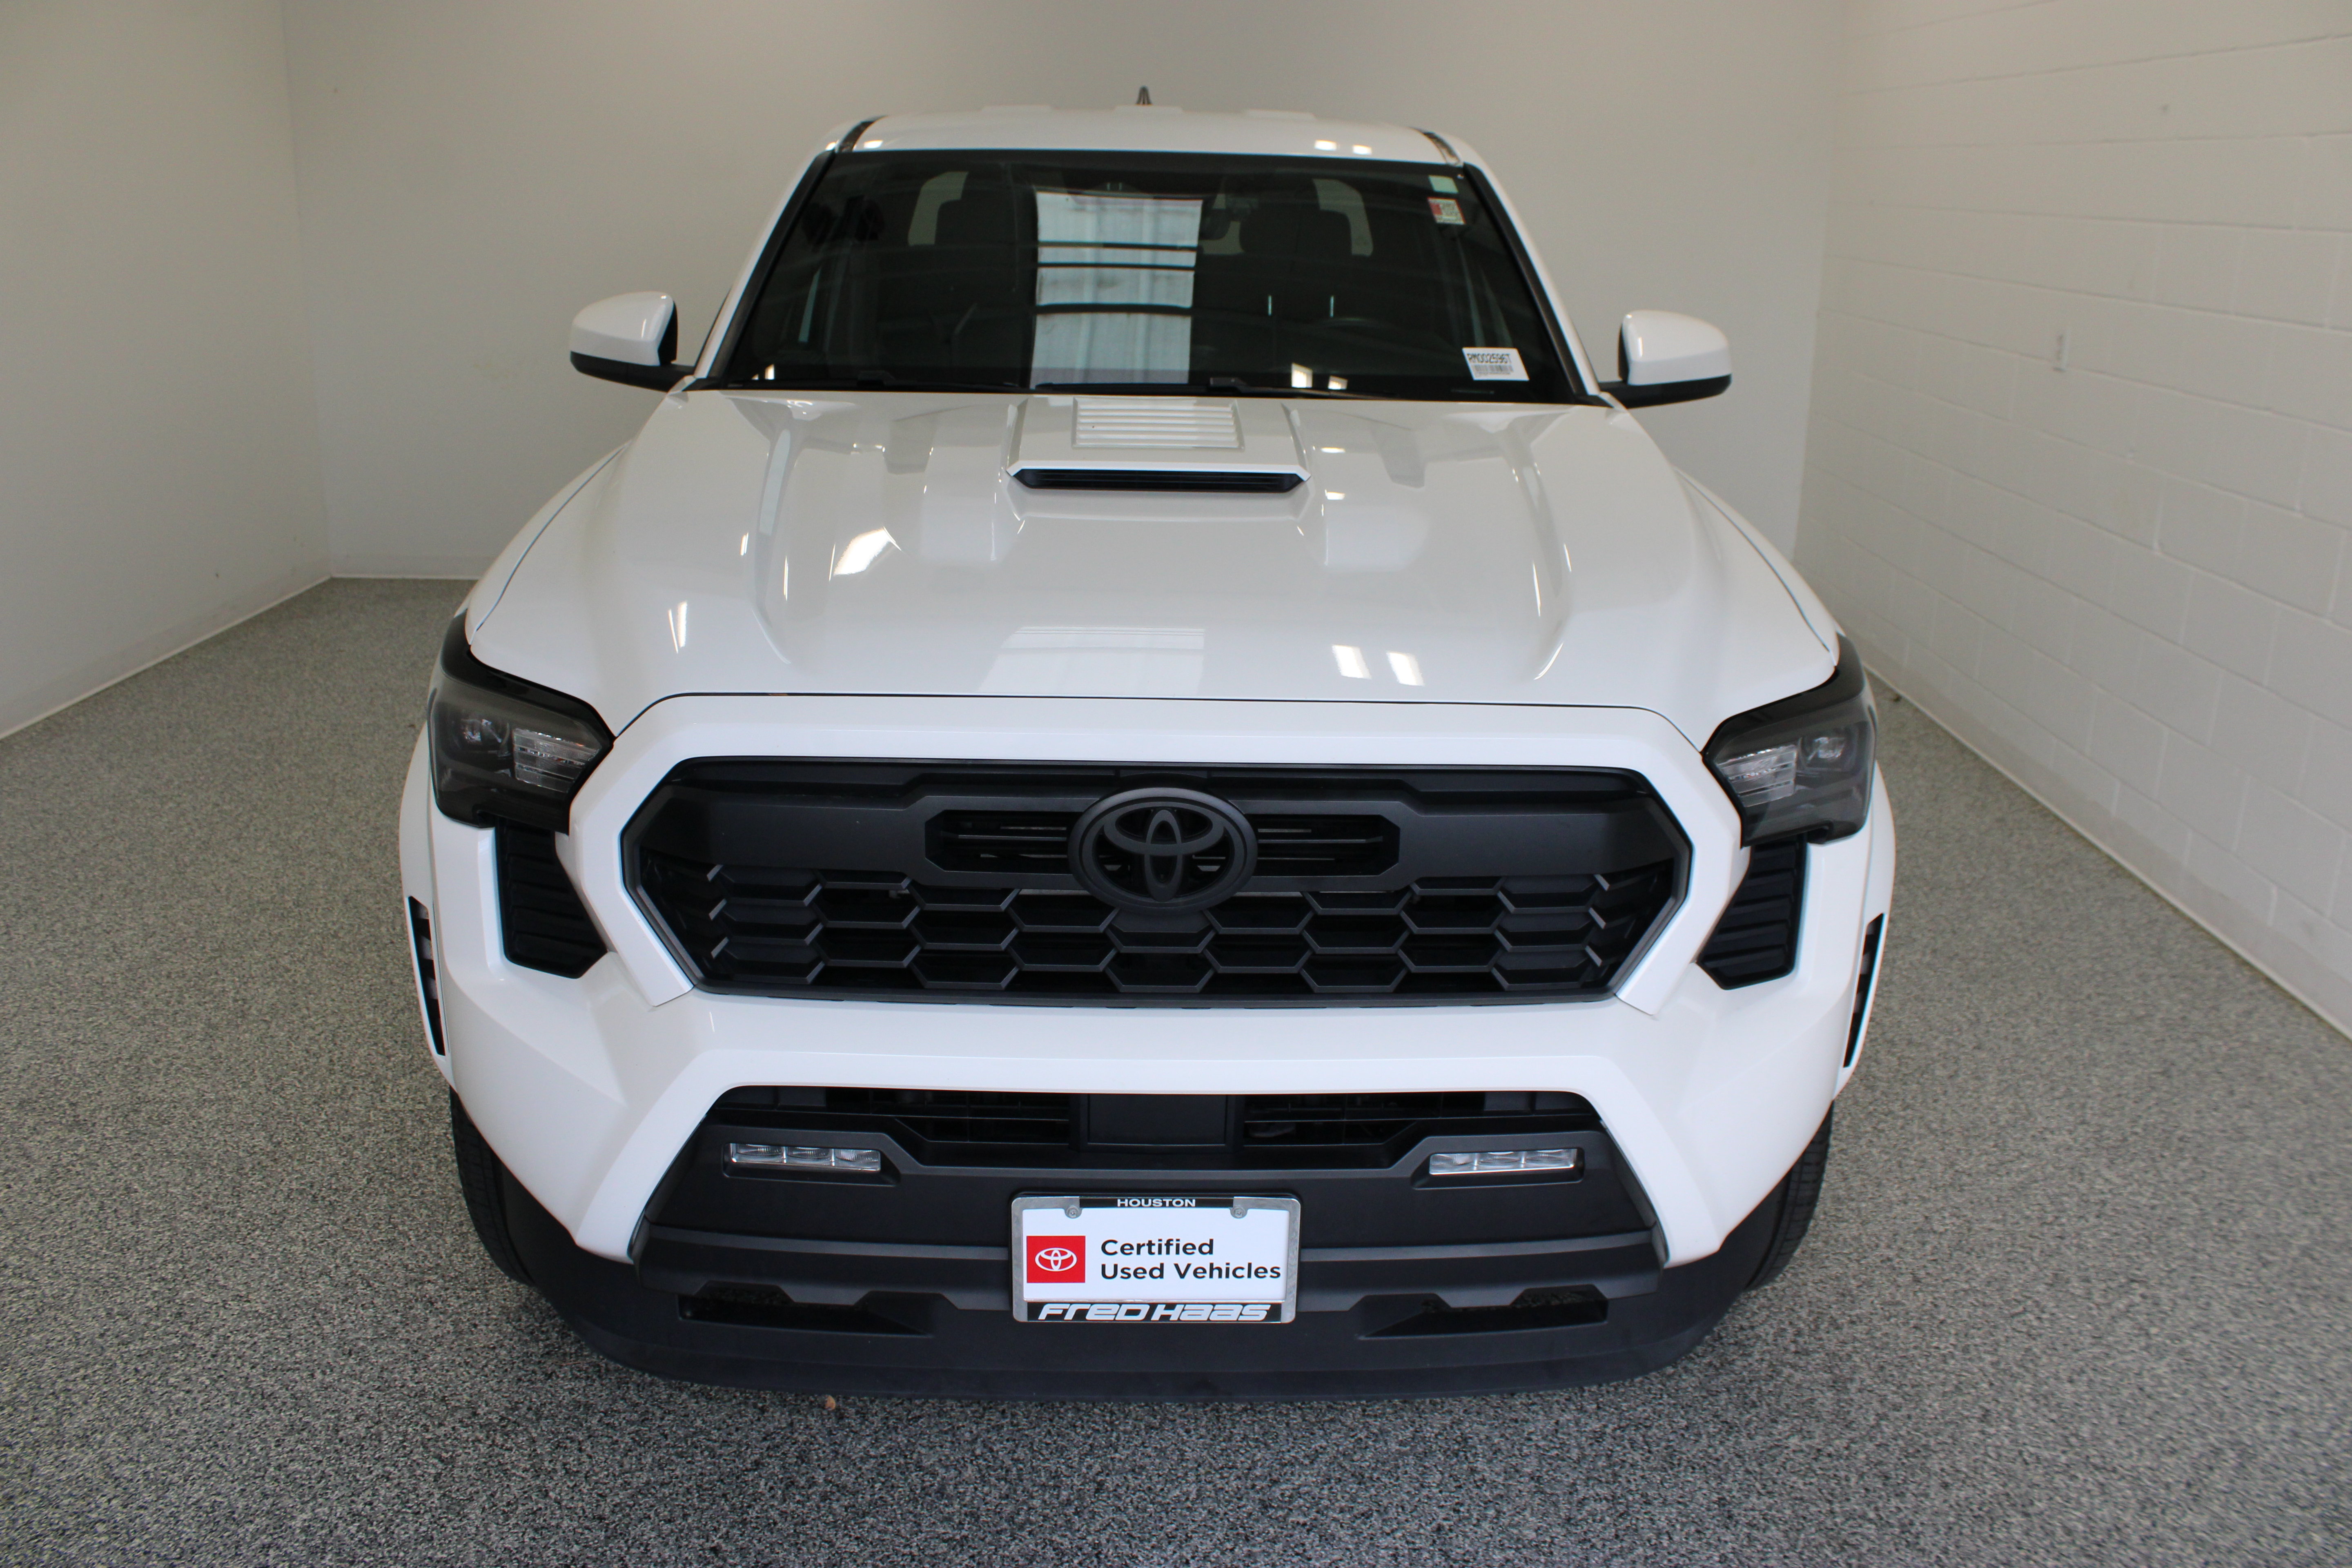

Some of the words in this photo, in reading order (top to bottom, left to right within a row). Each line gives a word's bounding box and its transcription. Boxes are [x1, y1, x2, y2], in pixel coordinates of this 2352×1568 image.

[1117, 1198, 1196, 1207] HOUSTON
[1101, 1238, 1214, 1256] Certified
[1101, 1263, 1165, 1280] Used
[1174, 1262, 1281, 1279] Vehicles
